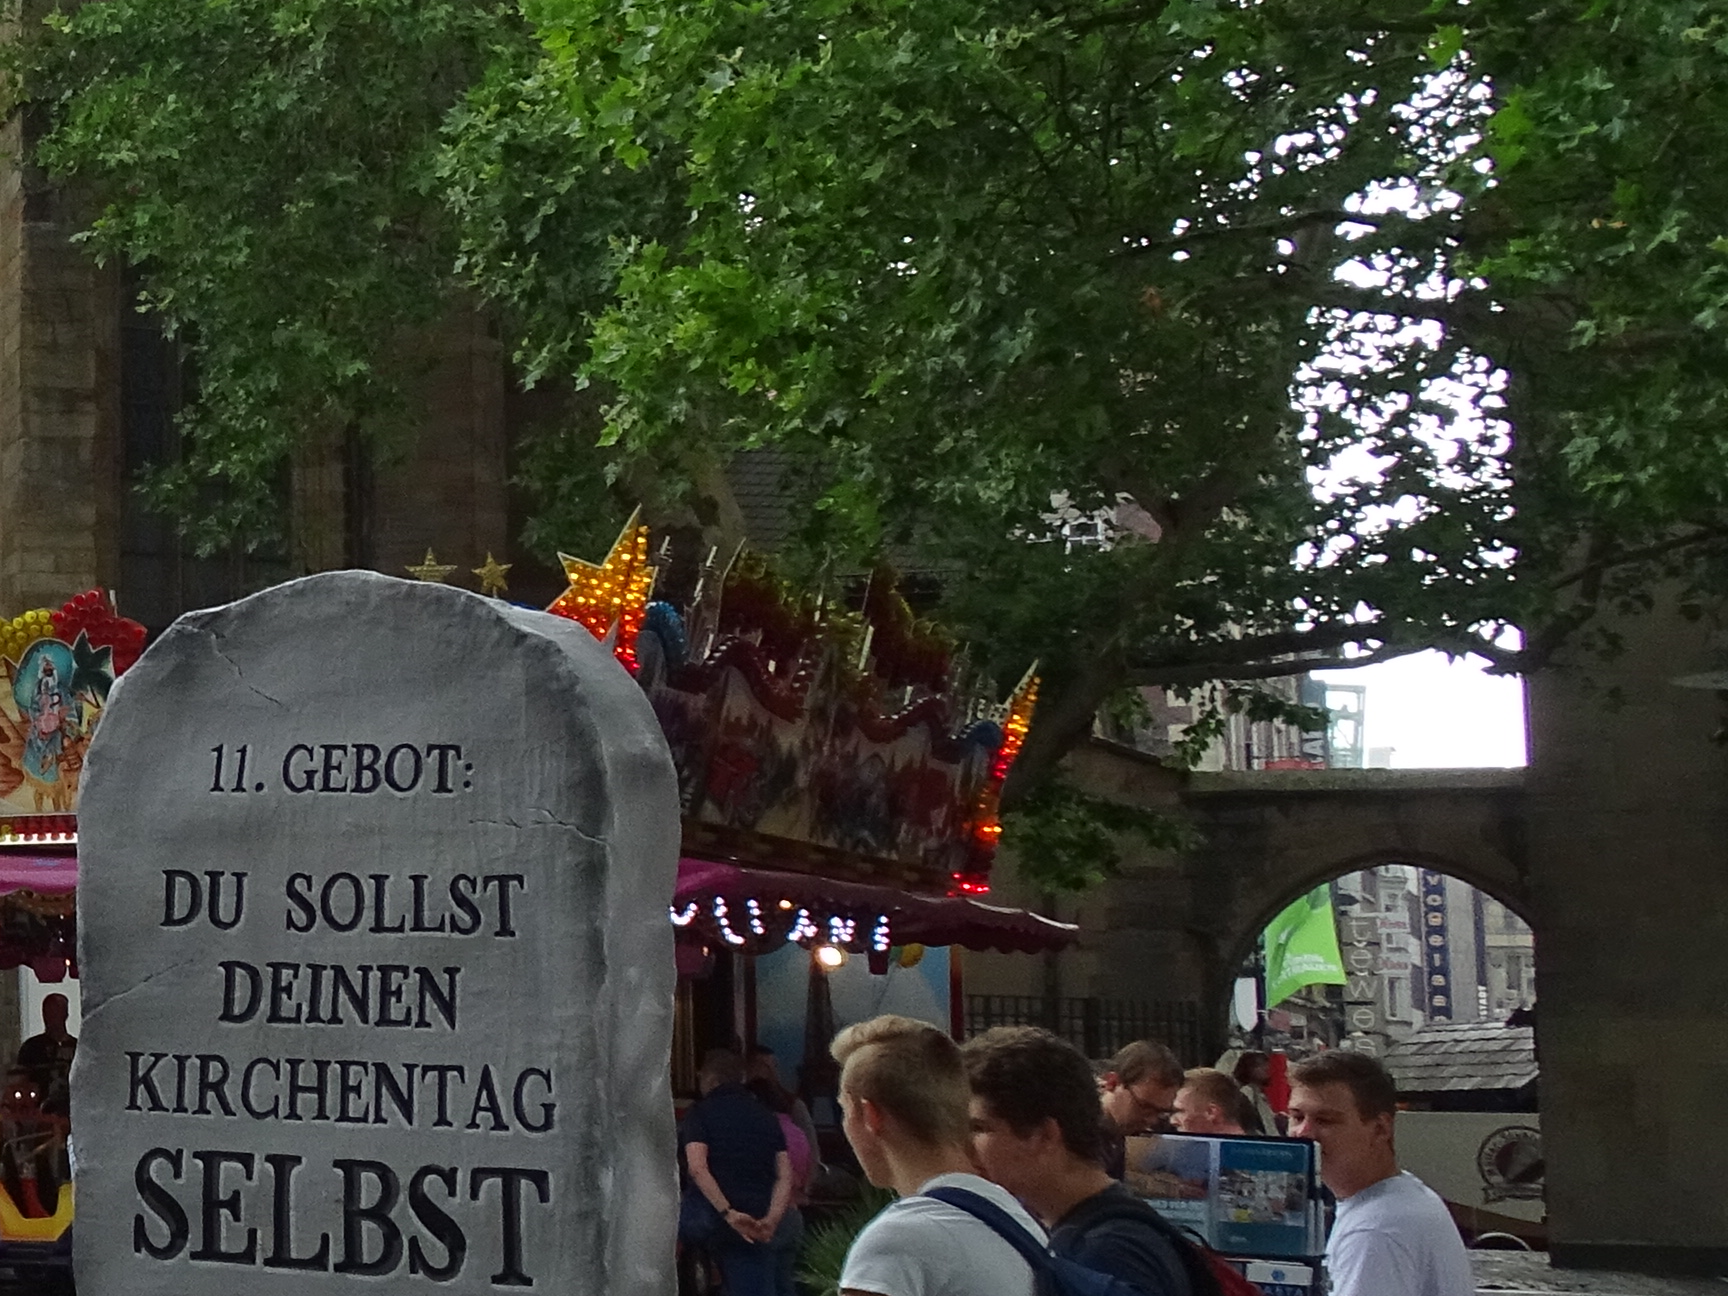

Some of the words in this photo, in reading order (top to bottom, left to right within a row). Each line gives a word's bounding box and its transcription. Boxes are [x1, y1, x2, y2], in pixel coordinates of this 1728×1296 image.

[208, 743, 265, 795] 11.
[281, 742, 474, 796] GEBOT:
[158, 868, 249, 931] DU
[284, 871, 525, 939] SOLLST
[216, 960, 462, 1032] DEINEN
[122, 1050, 558, 1135] KIRCHENTAG
[132, 1145, 550, 1288] SELBST
